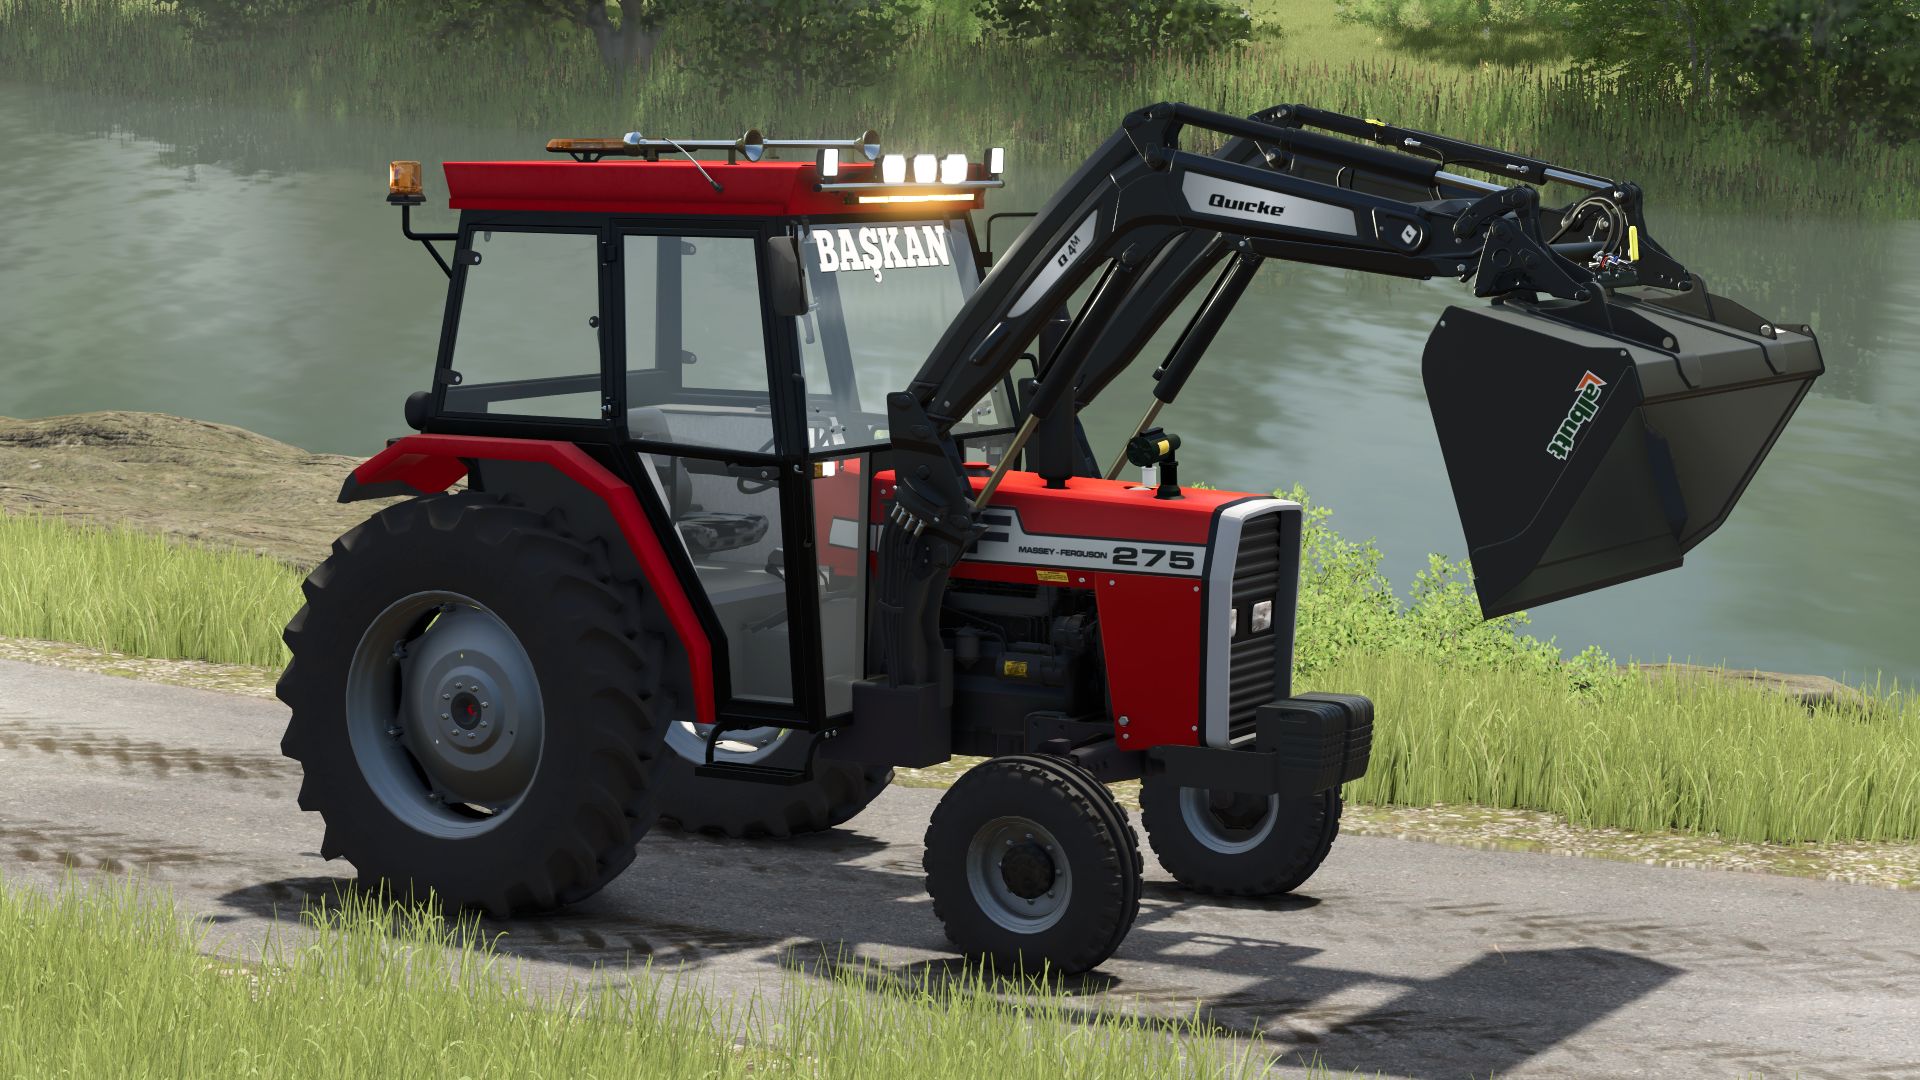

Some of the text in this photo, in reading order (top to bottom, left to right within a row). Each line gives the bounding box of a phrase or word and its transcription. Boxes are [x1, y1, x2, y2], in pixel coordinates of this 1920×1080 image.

[1209, 194, 1284, 216] Quicke
[812, 225, 950, 283] BAŞKAN
[1112, 547, 1195, 570] 275
